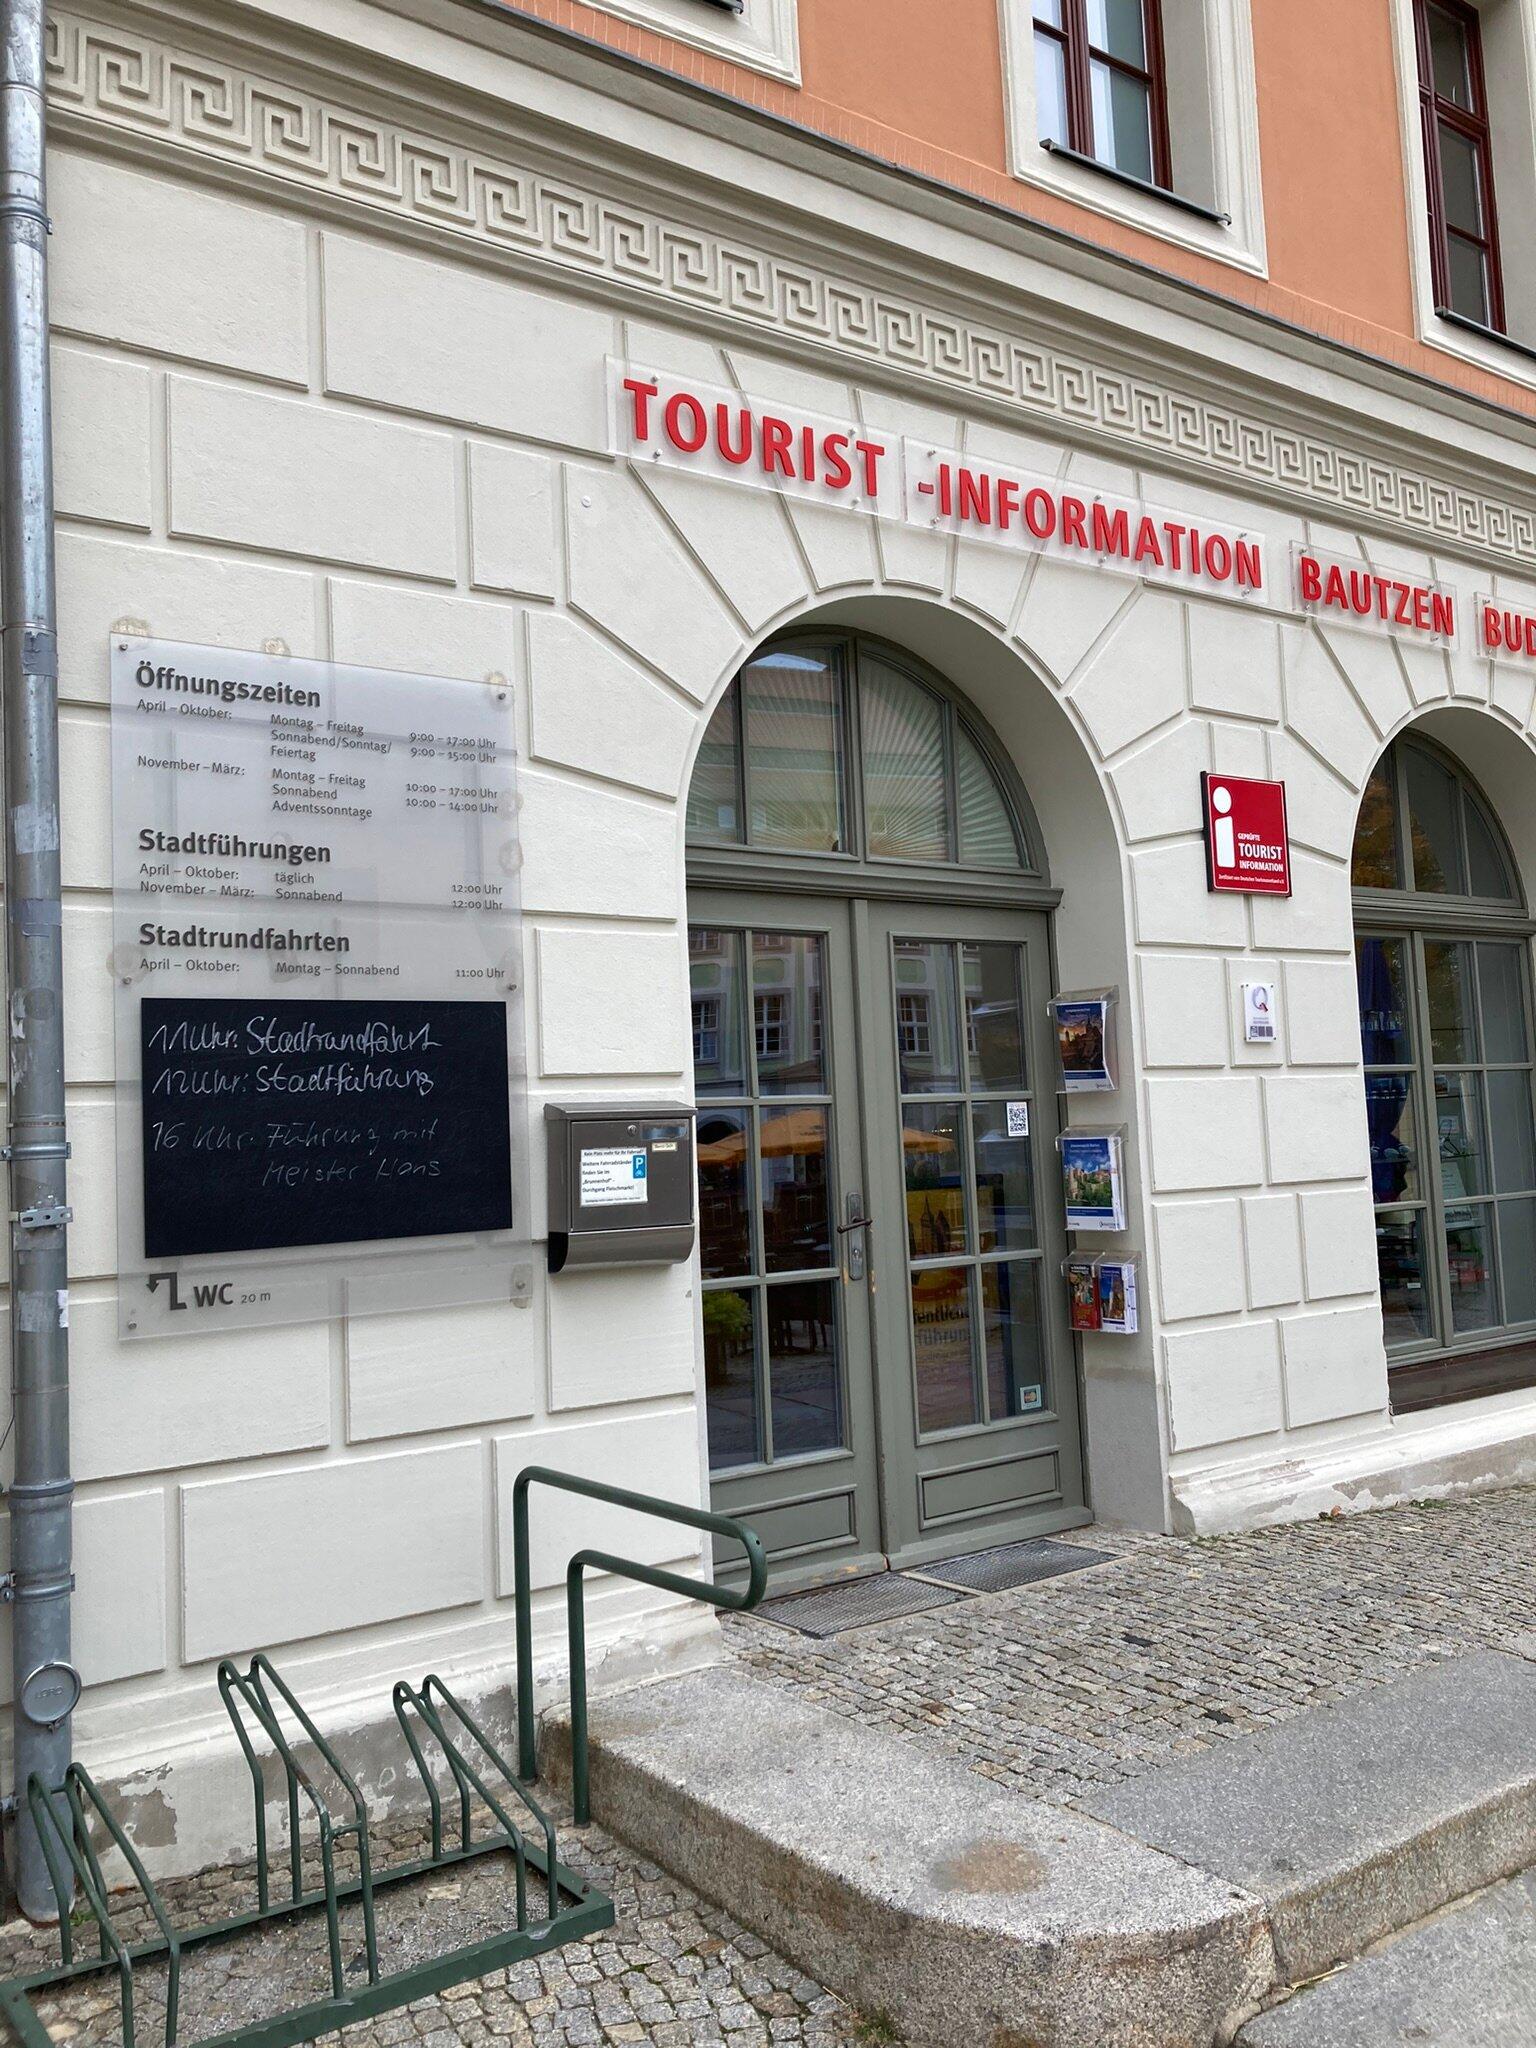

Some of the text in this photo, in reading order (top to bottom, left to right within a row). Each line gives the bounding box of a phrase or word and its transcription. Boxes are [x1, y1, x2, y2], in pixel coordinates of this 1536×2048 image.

[623, 378, 886, 498] TOURIST
[1301, 556, 1455, 637] BAUTZEN
[136, 660, 321, 708] Öffnungszeiten
[137, 699, 166, 714] April
[180, 702, 232, 720] Oktober:
[270, 714, 314, 731] Montag
[327, 720, 364, 737] Freitag
[409, 732, 434, 743] 9:00
[447, 736, 476, 747] 17:00
[478, 737, 497, 749] Uhr
[271, 745, 316, 762] Feiertag
[410, 747, 435, 758] 9:00
[447, 751, 476, 762] 15:00
[478, 752, 497, 763] Uhr
[138, 755, 200, 771] November
[212, 762, 245, 776] März:
[272, 767, 315, 785] Montag
[329, 773, 366, 789] Freitag
[272, 784, 338, 800] Sonnabend
[405, 783, 437, 793] 10:00
[449, 787, 477, 797] 17:00
[479, 788, 498, 799] Uhr
[272, 800, 373, 820] Adventssonntage
[405, 798, 437, 808] 10:00
[449, 801, 478, 812] 14:00
[479, 802, 499, 813] Uhr
[138, 828, 332, 866] Stadtführungen
[1238, 843, 1282, 860] TOURIST
[139, 863, 170, 876] April
[185, 865, 239, 880] Oktober:
[1239, 860, 1284, 872] INFORMATION
[275, 872, 315, 885] täglich
[140, 881, 205, 895] November
[220, 885, 255, 898] März:
[275, 888, 343, 902] Sonnabend
[452, 884, 503, 895] 12:00 Uhr
[452, 899, 503, 910] 12:00 Uhr
[139, 923, 350, 952] Stadtrundfahrten
[140, 958, 170, 972] April
[185, 959, 240, 972] Oktober:
[275, 962, 320, 976] Montag
[335, 963, 400, 976] Sonnabend
[455, 968, 505, 978] 11:00 Uhr
[256, 1062, 434, 1096] Stadtführung
[152, 1121, 186, 1151] 16
[393, 1117, 438, 1141] mit
[193, 1283, 271, 1308] WC 20 m
